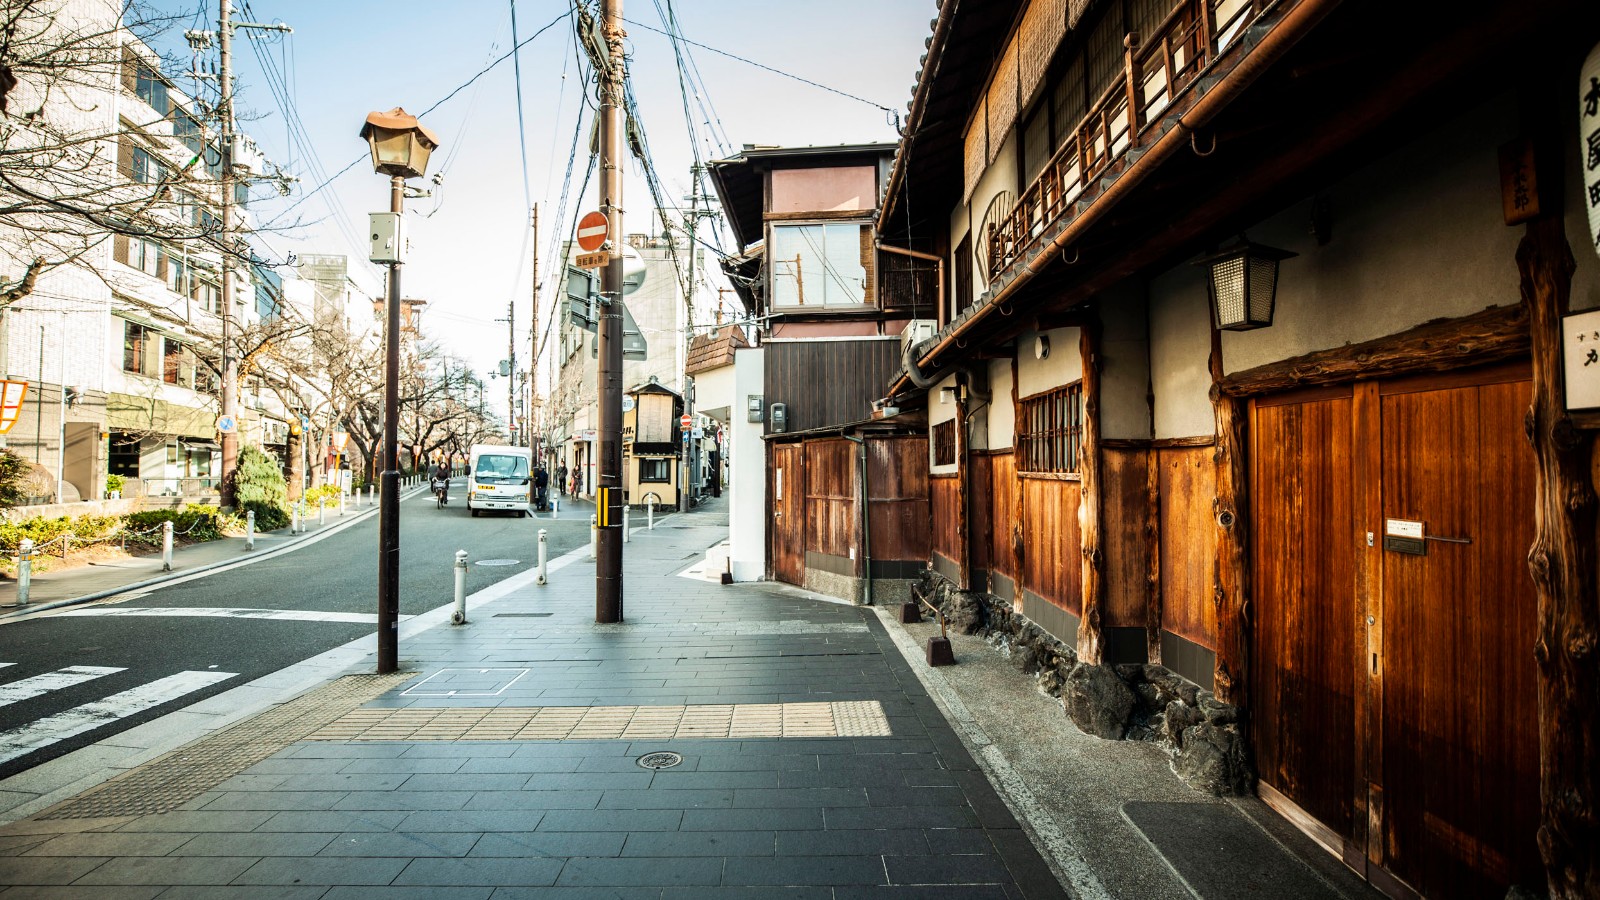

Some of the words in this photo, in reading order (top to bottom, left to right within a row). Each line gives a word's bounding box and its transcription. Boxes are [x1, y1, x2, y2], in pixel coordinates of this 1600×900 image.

[576, 255, 608, 267] 自転車を除く
